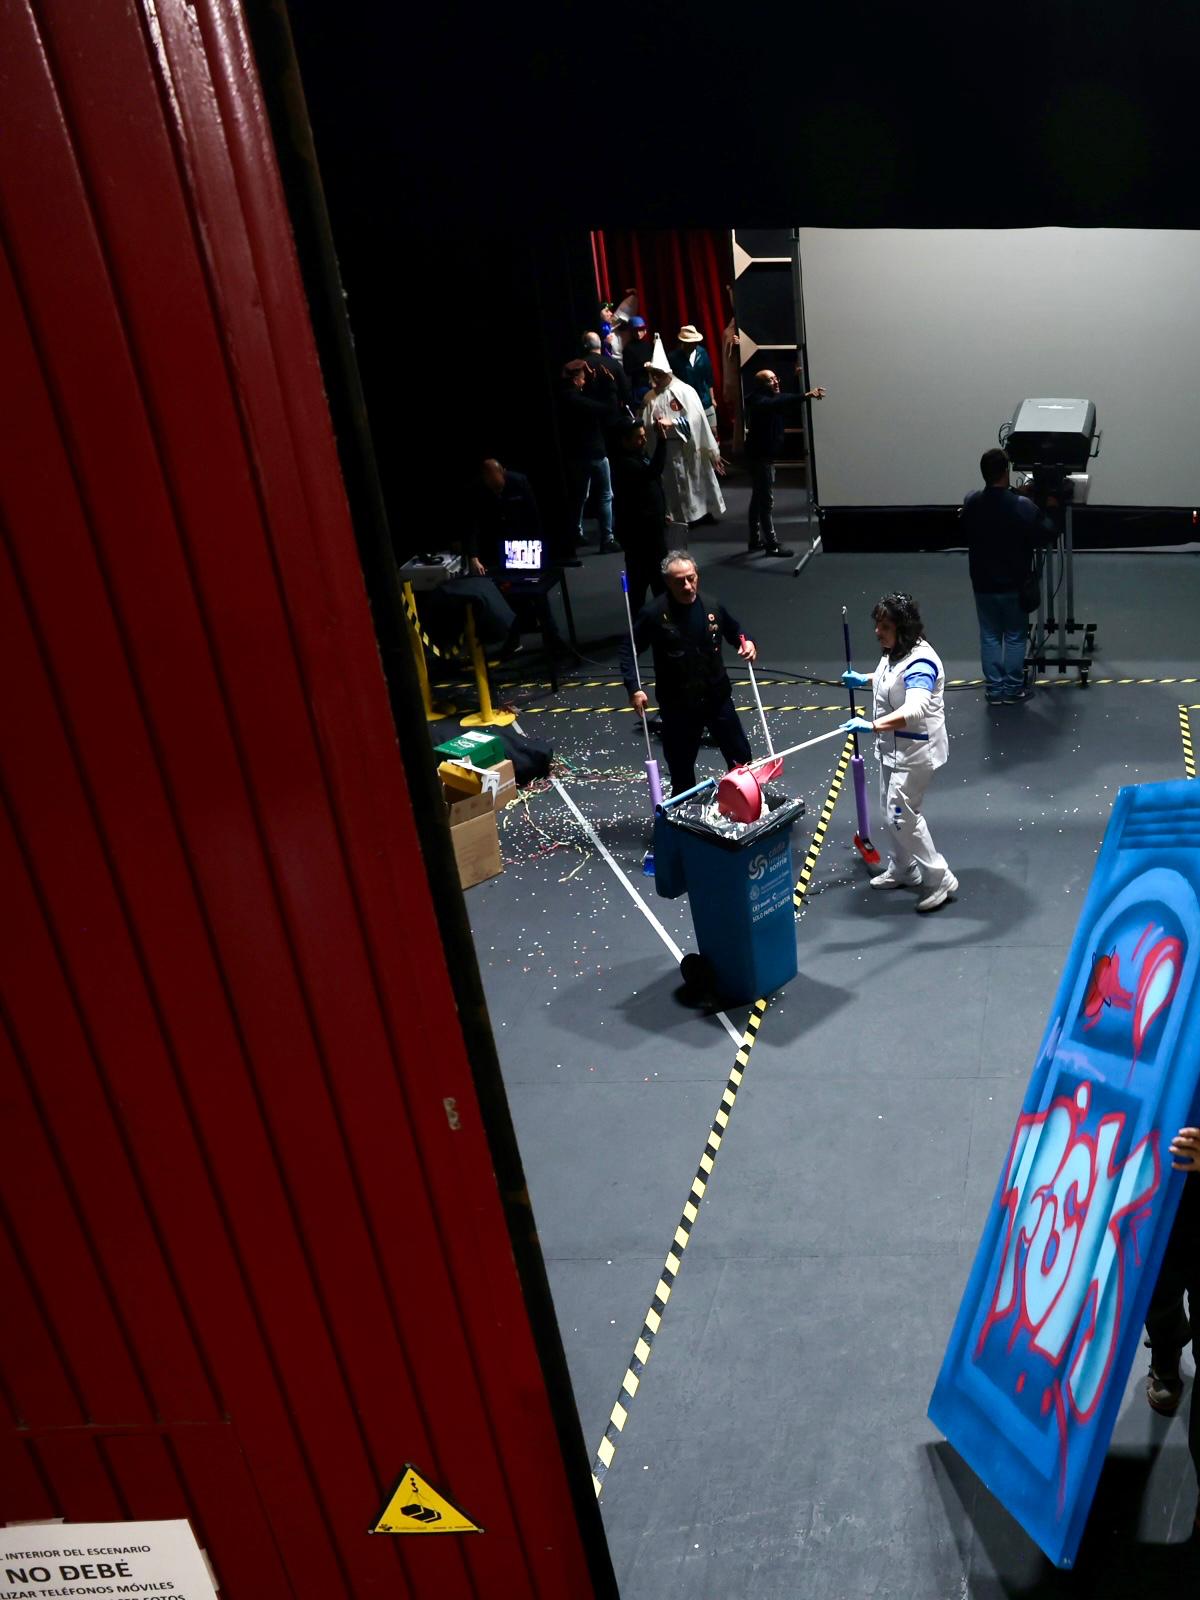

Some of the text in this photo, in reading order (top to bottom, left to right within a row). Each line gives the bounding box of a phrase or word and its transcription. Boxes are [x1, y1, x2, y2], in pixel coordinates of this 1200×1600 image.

[5, 1550, 61, 1560] INTERIOR
[63, 1549, 85, 1557] DEL
[87, 1545, 151, 1556] ESCENARIO
[5, 1566, 51, 1584] NO
[39, 1585, 114, 1597] TELÉFONOS
[117, 1582, 175, 1593] MÓVILES
